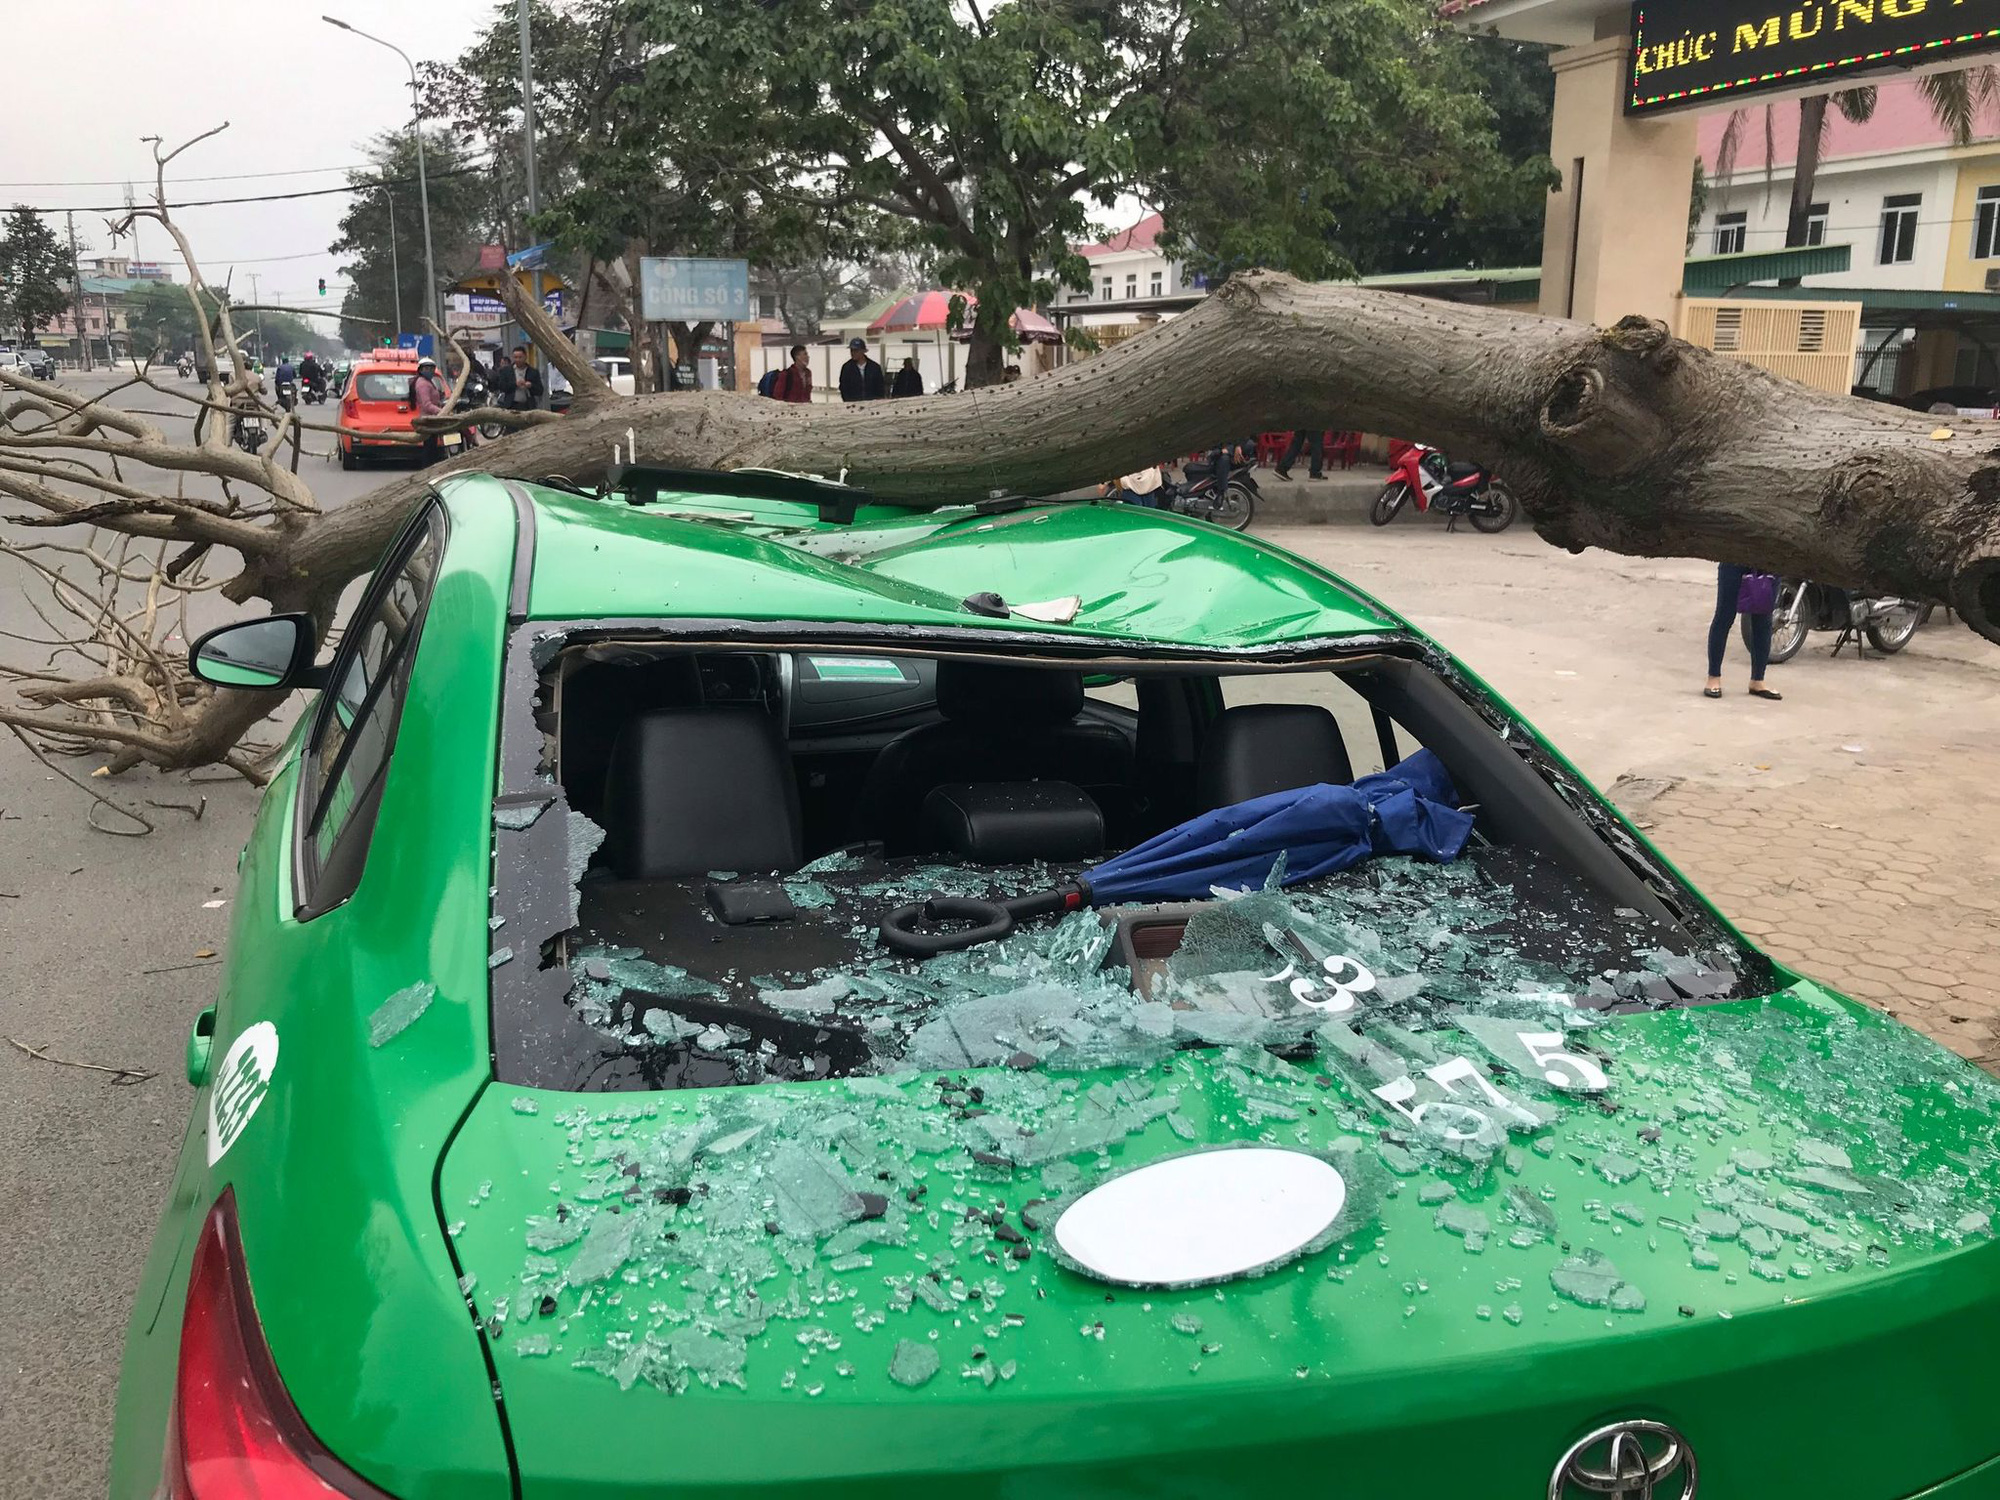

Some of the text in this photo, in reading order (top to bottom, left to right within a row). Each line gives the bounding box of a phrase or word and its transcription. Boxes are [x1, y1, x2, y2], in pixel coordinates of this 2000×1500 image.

[1637, 29, 1718, 74] CHÚC
[704, 281, 729, 305] SỐ
[734, 287, 745, 305] 3
